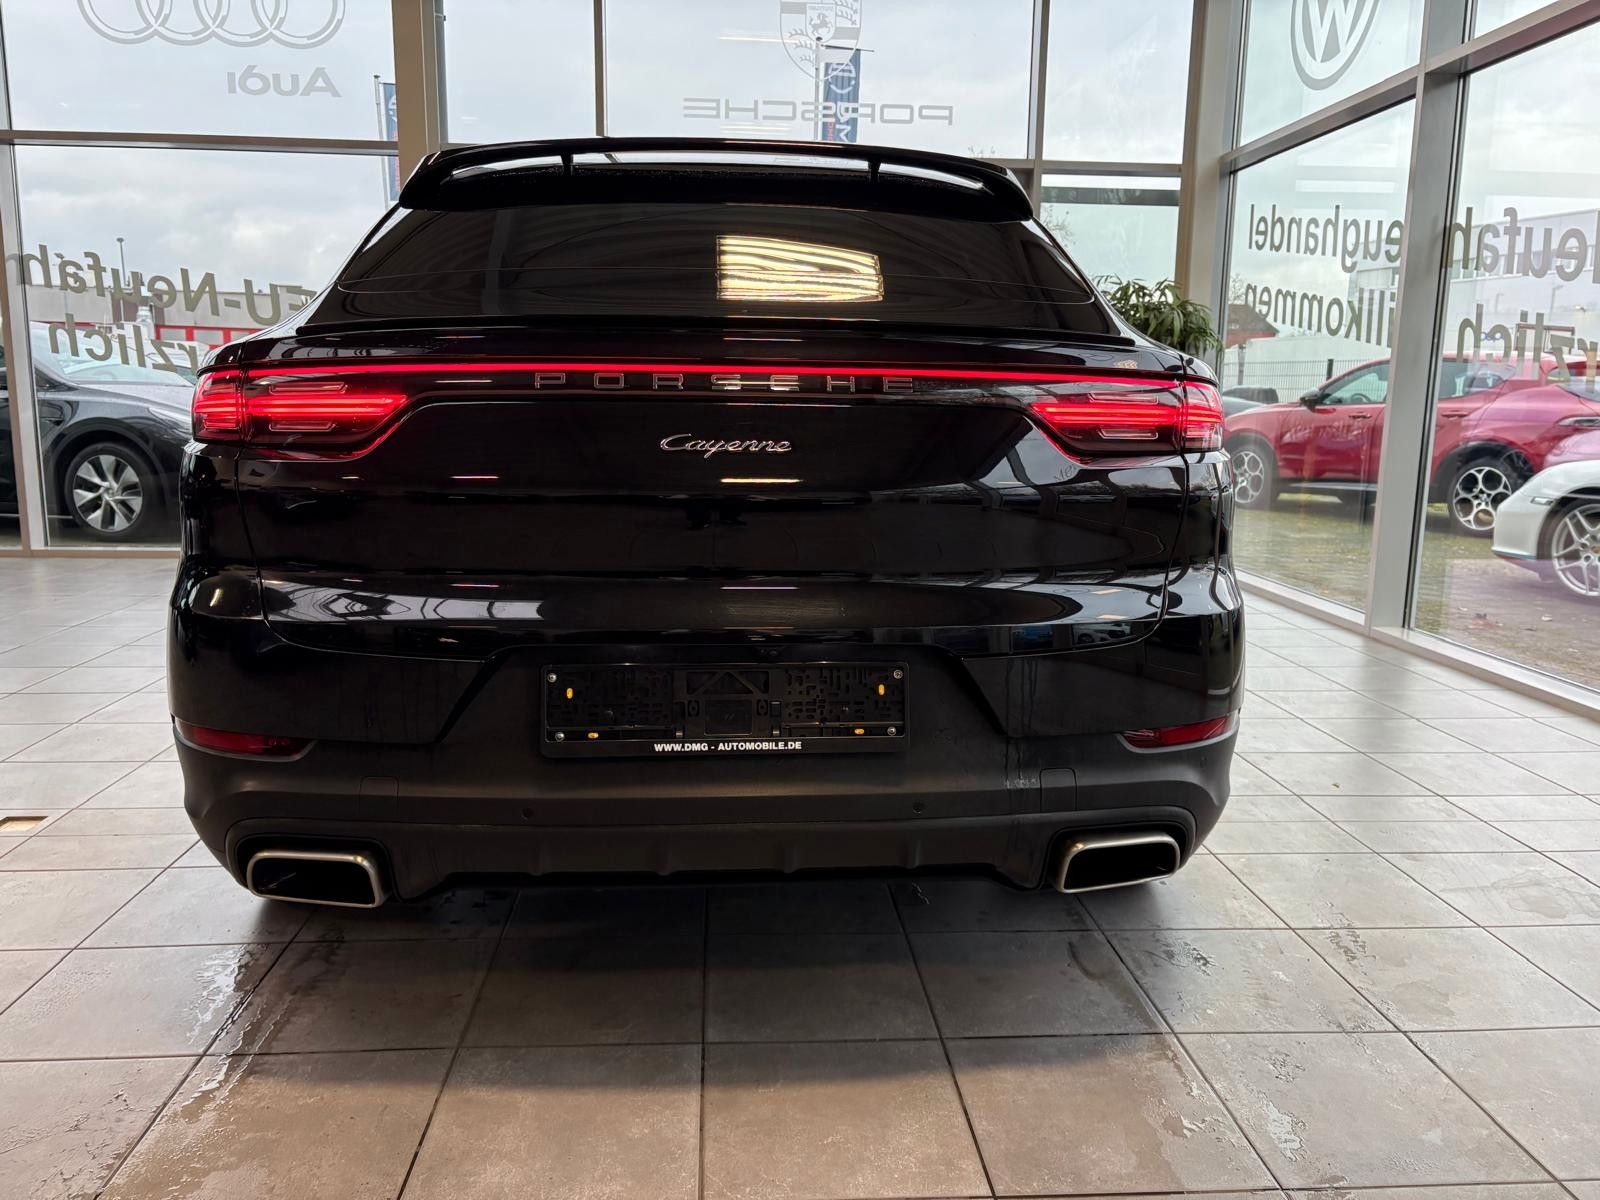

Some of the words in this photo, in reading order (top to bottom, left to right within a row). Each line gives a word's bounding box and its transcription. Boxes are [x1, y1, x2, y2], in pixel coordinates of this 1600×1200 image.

[535, 372, 913, 393] PORSCHE
[659, 433, 792, 459] Cayenne
[654, 742, 708, 752] WWW.DMG
[718, 741, 802, 751] AUTOMOBILE.DE
